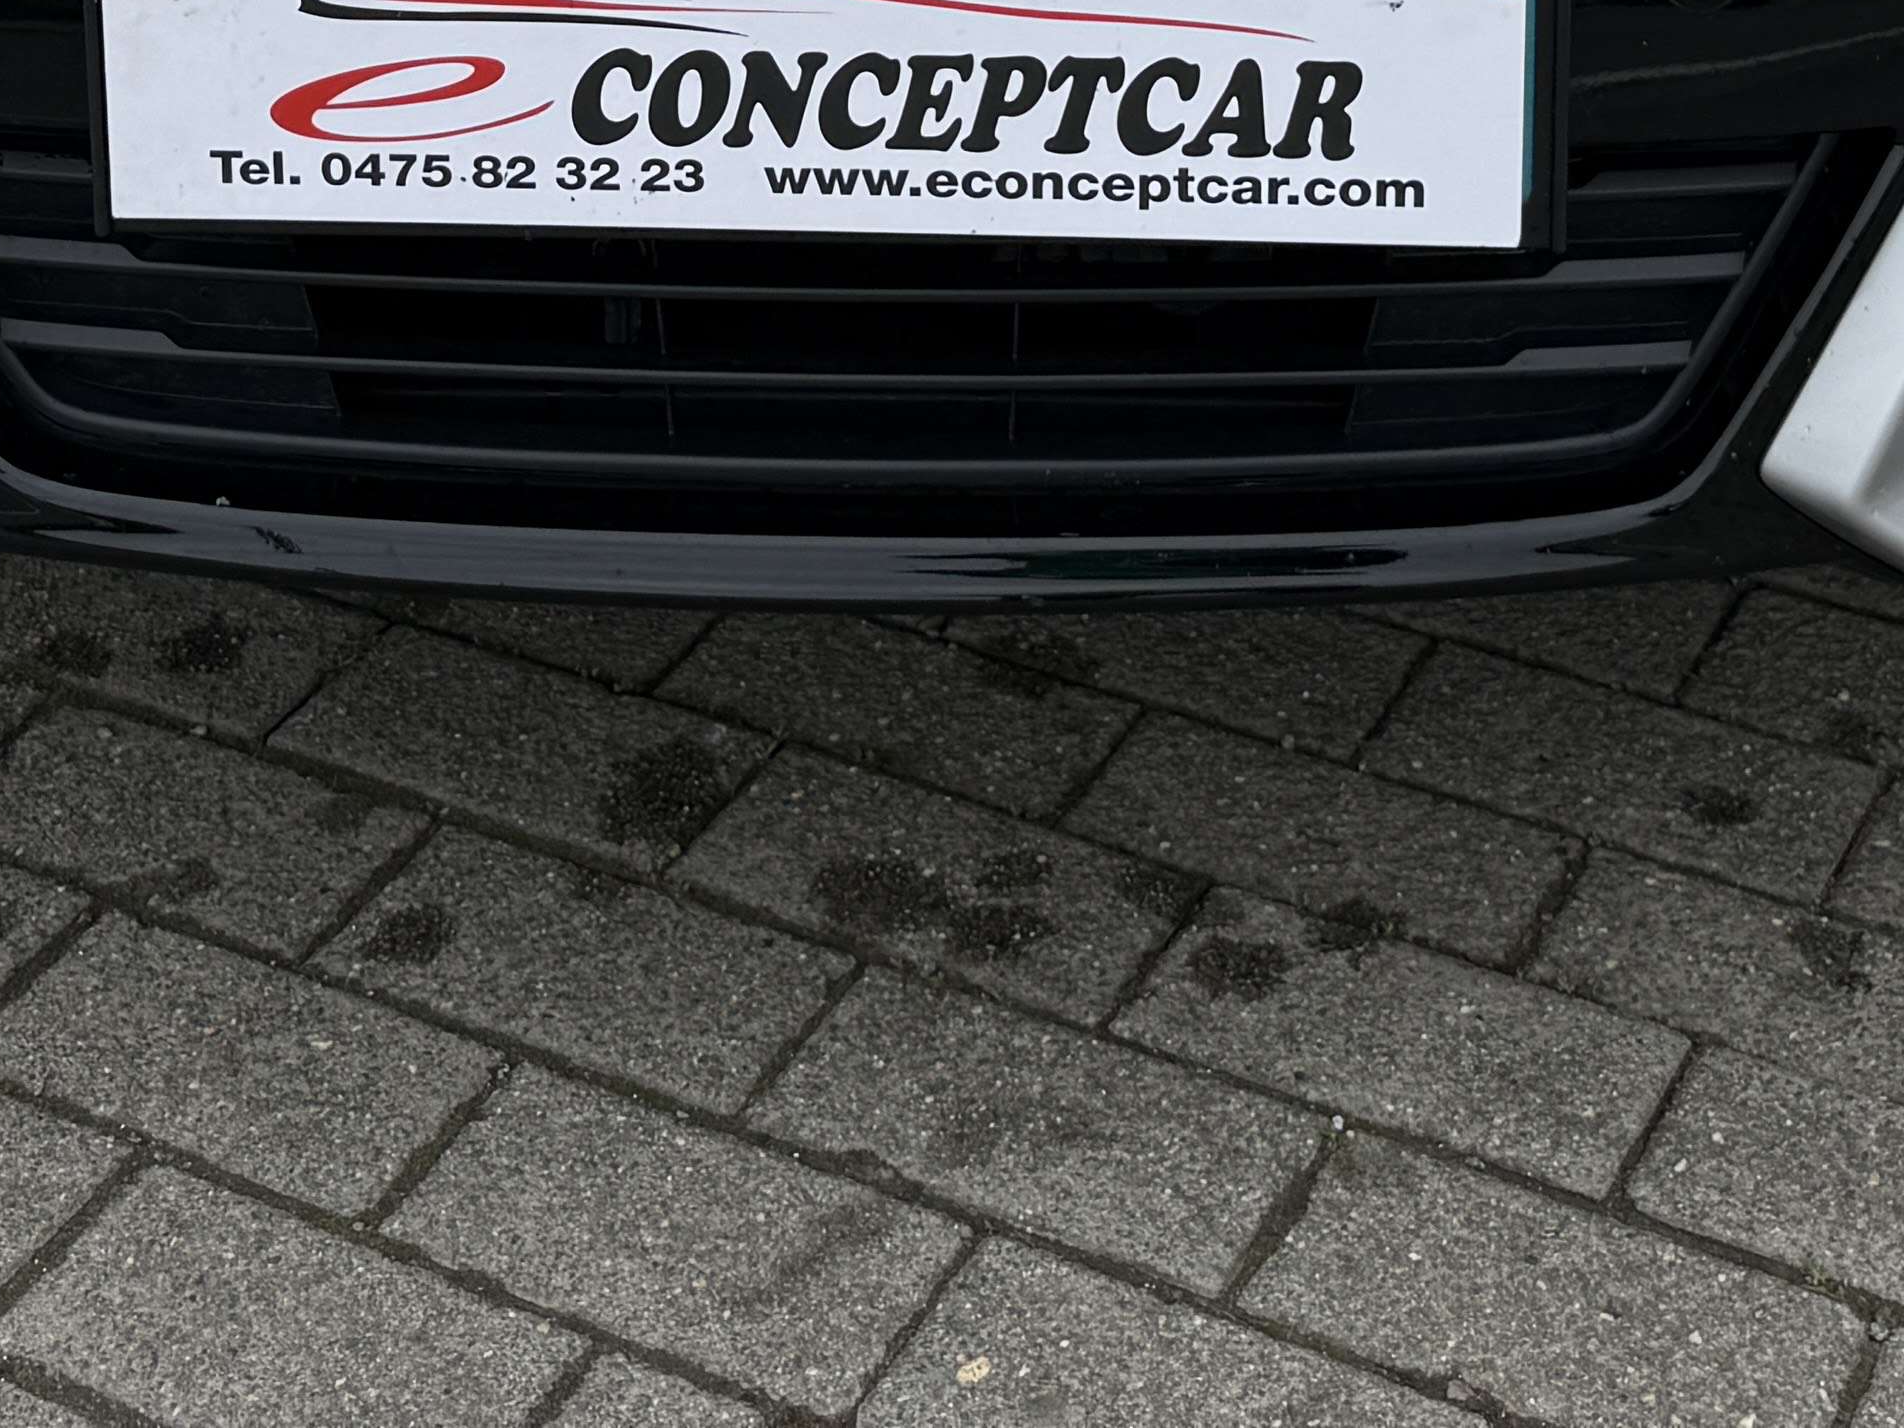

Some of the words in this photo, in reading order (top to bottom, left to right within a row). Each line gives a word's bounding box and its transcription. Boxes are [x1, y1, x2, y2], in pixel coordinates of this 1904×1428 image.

[570, 46, 1364, 162] CONCEPTCAR
[208, 149, 302, 186] Tel.
[320, 151, 453, 189] 0475
[470, 154, 538, 191] 82
[554, 155, 622, 192] 32
[639, 157, 706, 194] 23
[762, 165, 1426, 212] www.econceptcar.com
